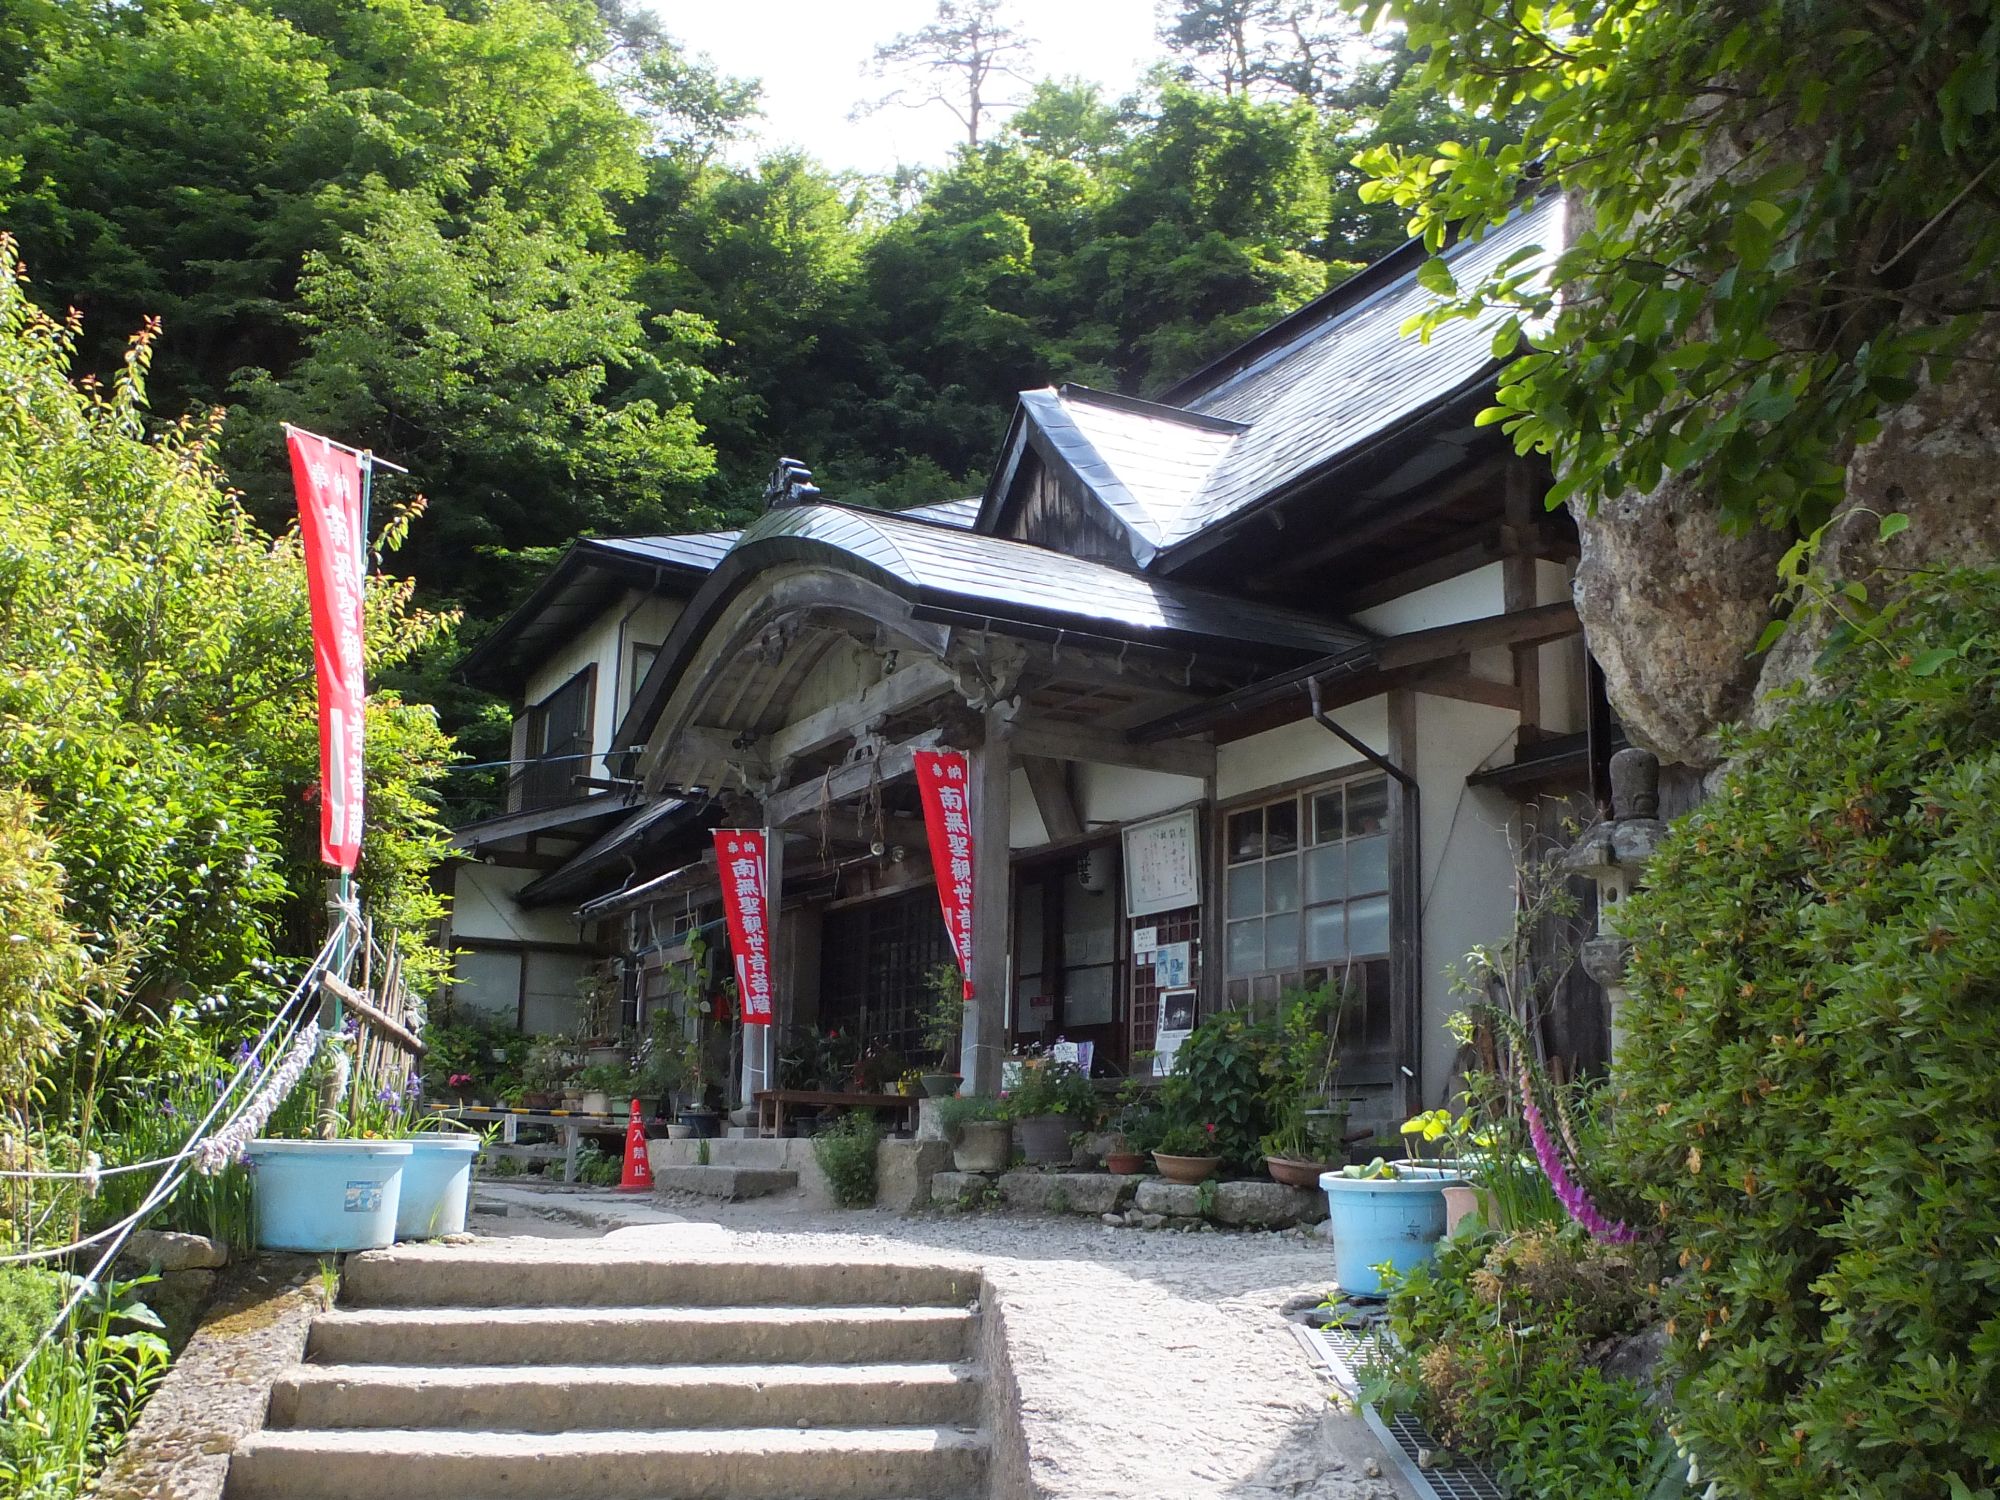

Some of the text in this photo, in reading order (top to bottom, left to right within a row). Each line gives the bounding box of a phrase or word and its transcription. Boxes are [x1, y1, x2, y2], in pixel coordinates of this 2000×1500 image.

[311, 462, 350, 500] 奉納
[932, 763, 962, 779] 奉納
[728, 841, 755, 853] 奉納
[938, 785, 971, 981] 南無聖観世音菩
[731, 858, 771, 1013] 南無聖観世音菩薩
[632, 1112, 645, 1176] 立入禁止
